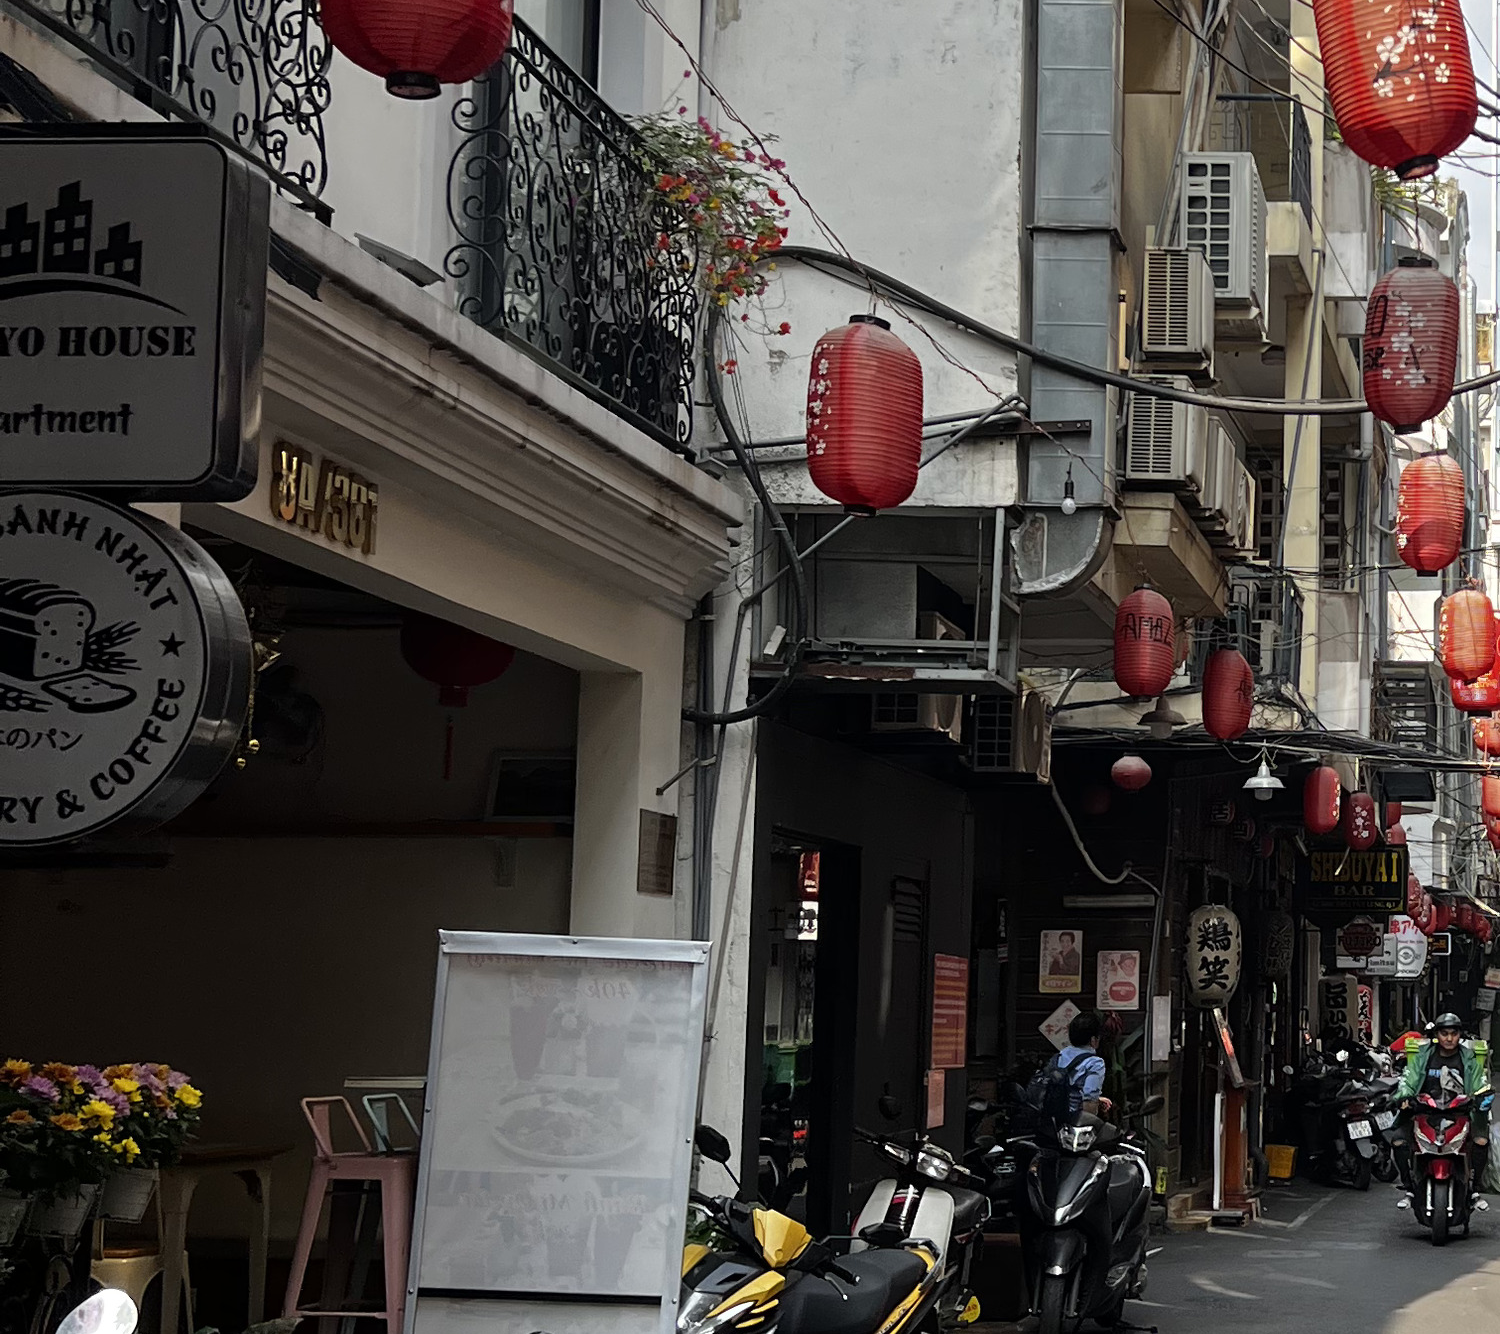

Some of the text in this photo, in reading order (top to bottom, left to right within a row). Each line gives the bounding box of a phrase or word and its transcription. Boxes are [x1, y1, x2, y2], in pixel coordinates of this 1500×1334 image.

[57, 325, 196, 357] HOUSE
[56, 789, 86, 819] &
[90, 678, 186, 801] COFFEE
[1310, 851, 1388, 883] SHIBUYA
[1334, 885, 1377, 897] BAR
